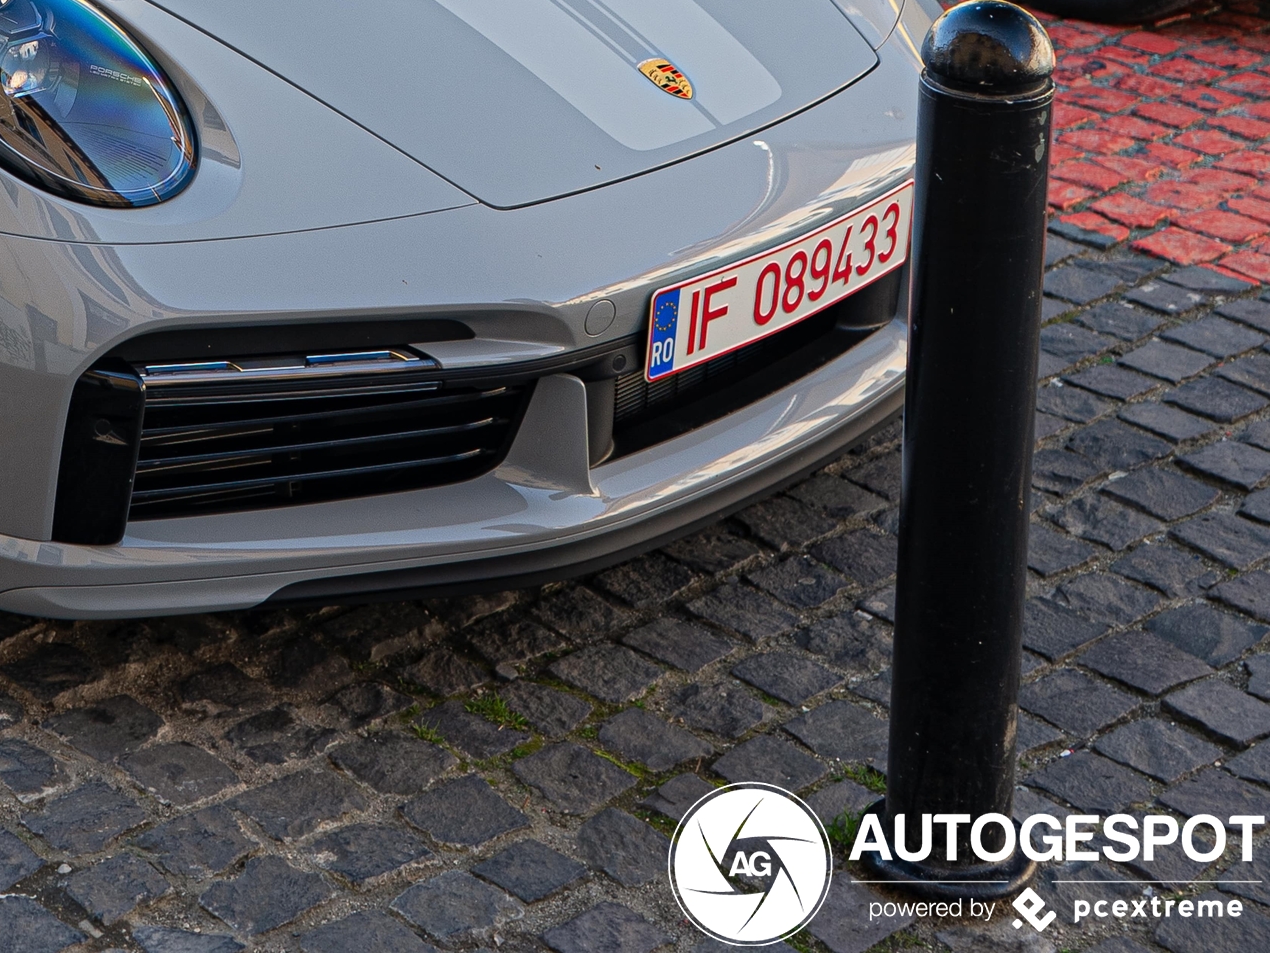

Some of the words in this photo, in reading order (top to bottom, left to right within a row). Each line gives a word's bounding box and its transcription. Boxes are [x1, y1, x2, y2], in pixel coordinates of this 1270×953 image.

[90, 64, 142, 84] PORSCHE
[686, 275, 739, 357] IF
[753, 201, 901, 327] 089433
[650, 337, 674, 368] RO
